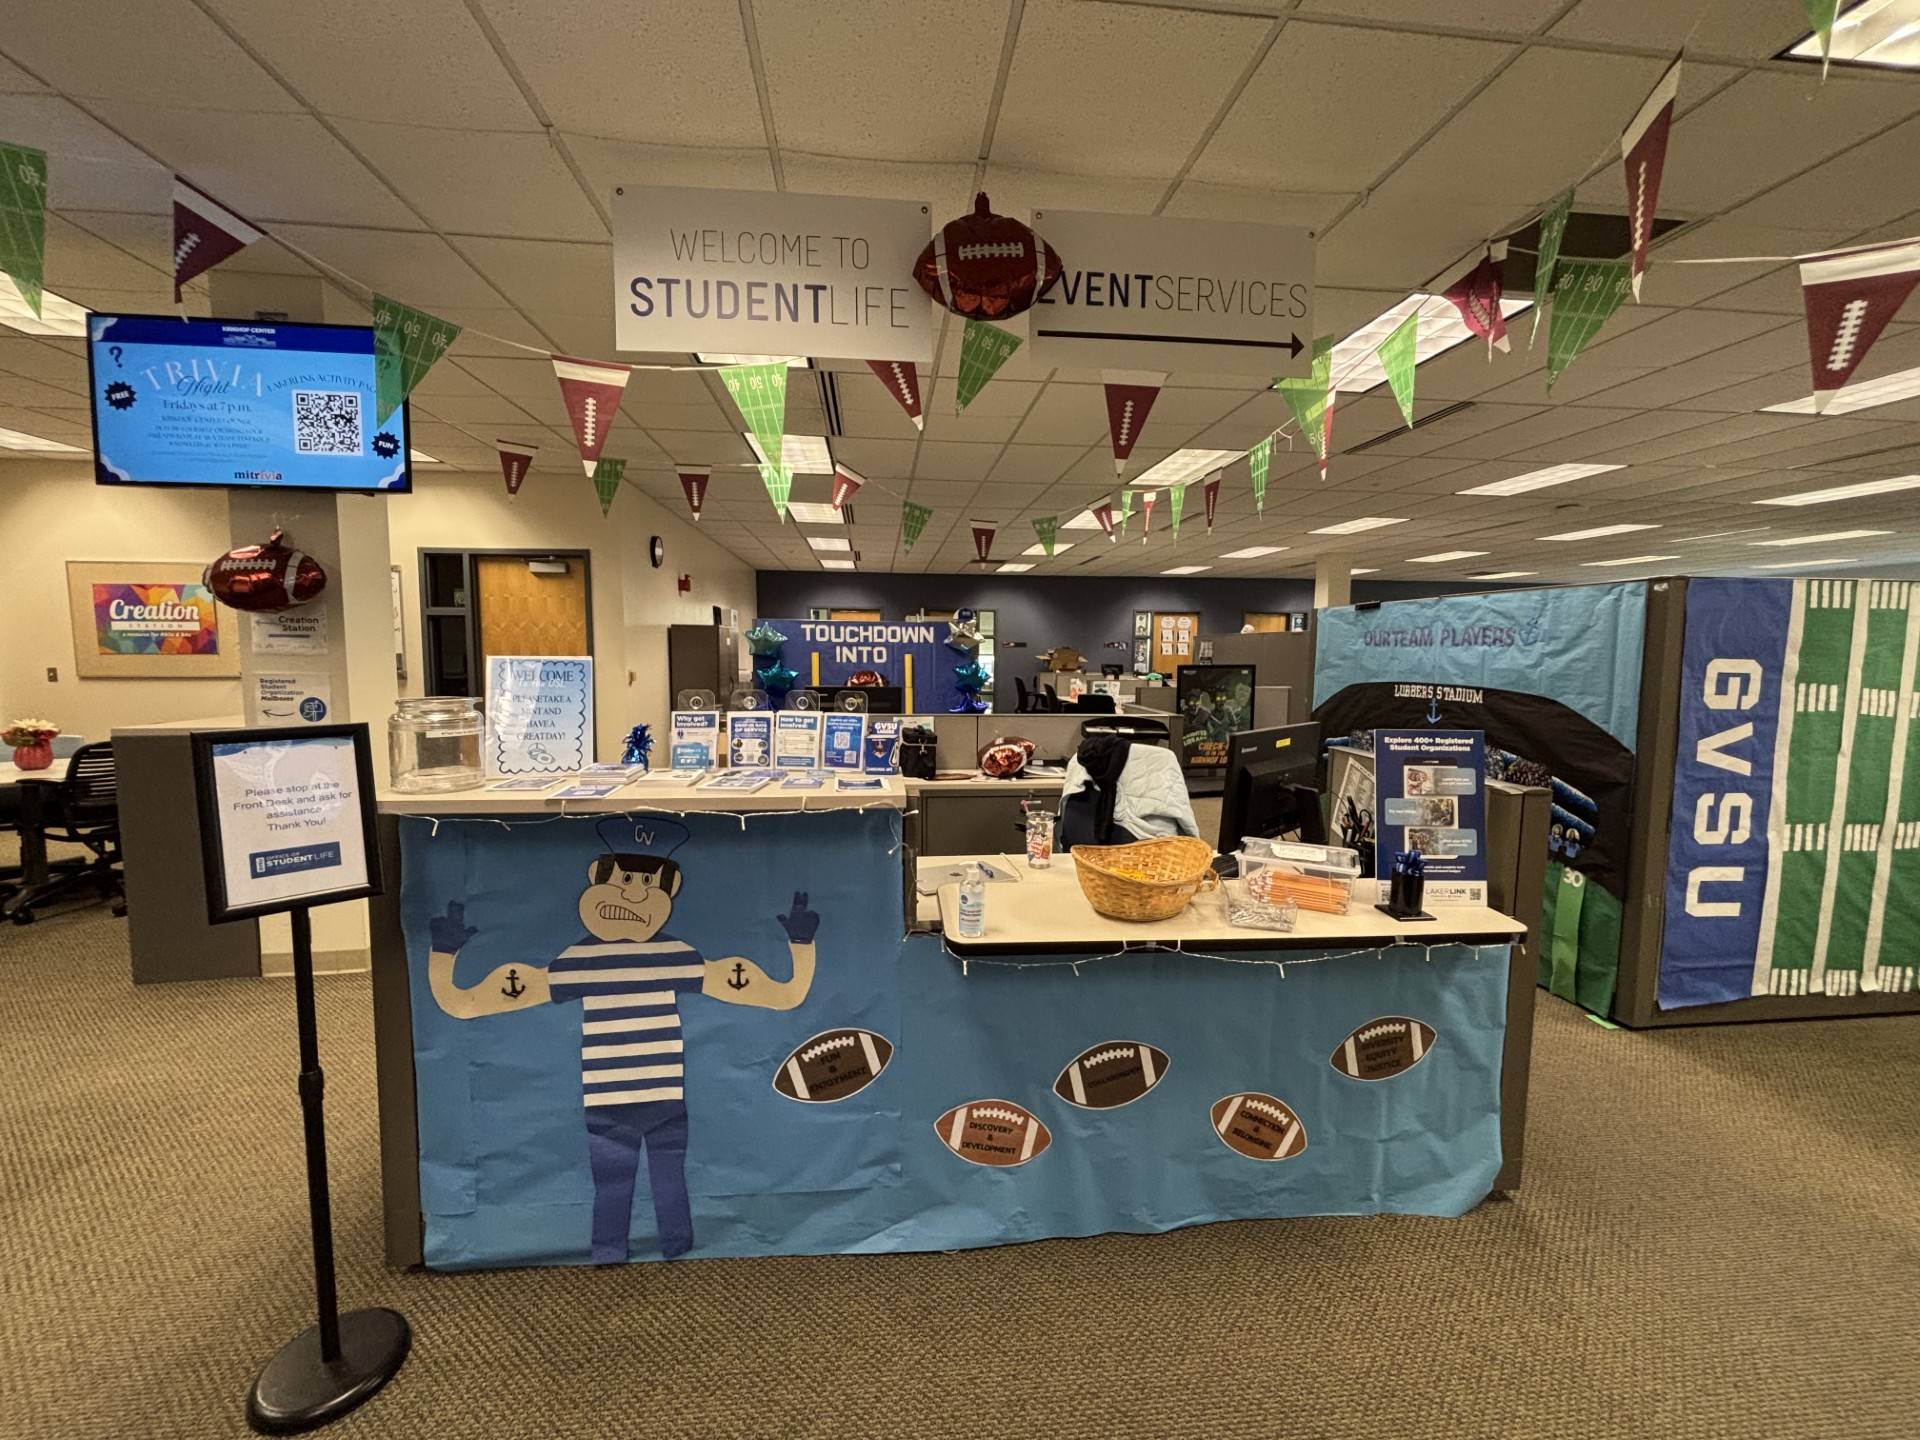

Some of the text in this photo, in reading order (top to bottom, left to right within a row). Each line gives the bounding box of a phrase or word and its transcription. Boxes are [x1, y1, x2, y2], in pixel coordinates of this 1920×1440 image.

[670, 228, 870, 270] WELCOME TO
[629, 276, 910, 329] STUDENTLIFE
[140, 359, 263, 398] TRIVIA
[176, 375, 231, 398] Night
[111, 390, 130, 401] FREE
[163, 400, 204, 414] Fridays
[206, 401, 218, 412] at
[219, 401, 227, 411] 7
[378, 440, 395, 450] FUN
[234, 470, 283, 481] mitrivia
[109, 599, 200, 621] Creation
[128, 622, 184, 630] STATION
[279, 615, 319, 624] Creation
[282, 624, 316, 632] Station
[800, 624, 935, 644] TOUCHDOWN
[1439, 625, 1517, 648] PLAYERS
[835, 645, 888, 664] INTO
[511, 669, 575, 682] WELCOME
[512, 694, 545, 703] PLEASE
[545, 694, 565, 703] TAKE
[1393, 683, 1484, 704] LUBBERS STADIUM
[544, 706, 562, 716] AND
[677, 715, 693, 723] Why
[803, 717, 814, 725] get
[874, 722, 898, 730] GVSU
[1384, 736, 1474, 746] Explore 400+ Registered
[1421, 744, 1471, 752] Organizations
[245, 786, 284, 798] Please
[286, 784, 308, 795] stop
[1684, 657, 1764, 918] GVSU
[233, 800, 263, 812] Front
[296, 794, 316, 804] and
[318, 793, 337, 802] ask
[339, 791, 353, 800] for
[266, 807, 323, 819] assistance
[267, 816, 327, 832] Thank You!
[1562, 866, 1584, 888] 30
[820, 1051, 842, 1065] FUN
[809, 1066, 867, 1093] ENJOYMENT
[969, 1121, 1014, 1134] DISCOVERY
[1240, 1109, 1285, 1135] CONNECTION
[1231, 1127, 1273, 1150] BELONGING
[961, 1141, 1017, 1154] DEVELOPMENT
